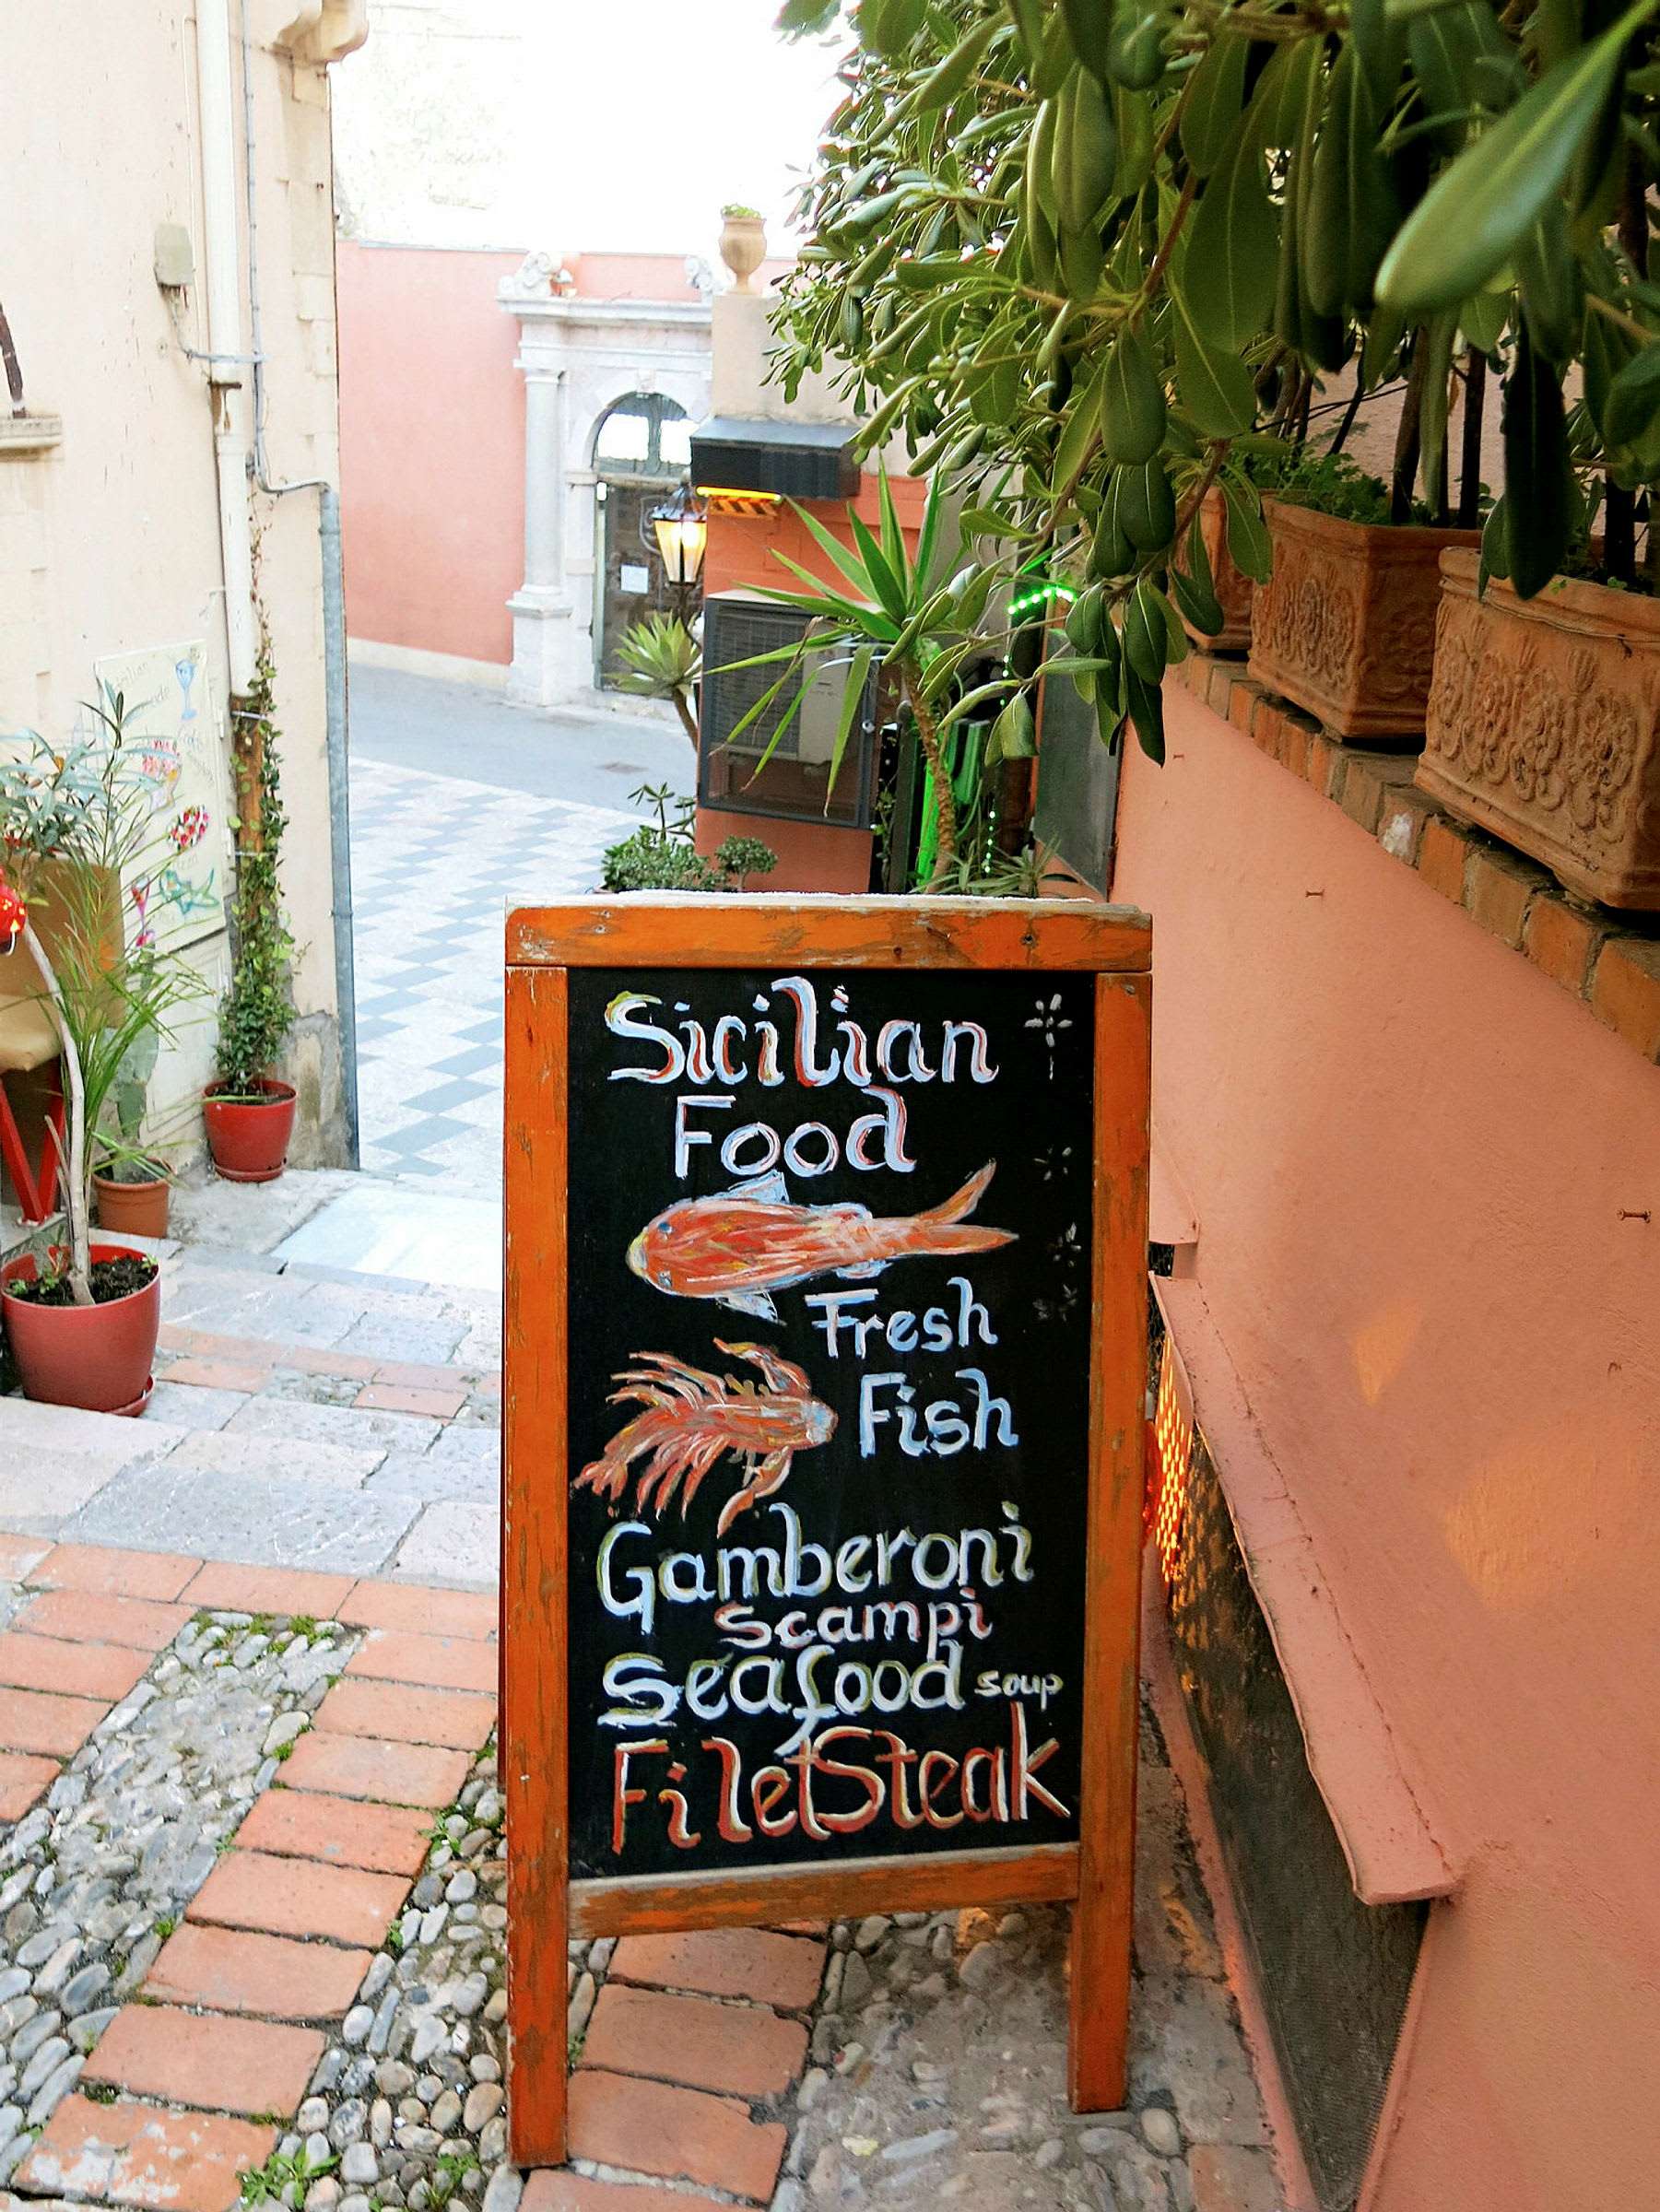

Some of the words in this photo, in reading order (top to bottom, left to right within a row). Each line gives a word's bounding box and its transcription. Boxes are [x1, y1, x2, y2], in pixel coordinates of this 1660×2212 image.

[605, 976, 999, 1088] Sicilian
[675, 1085, 916, 1178] Food
[805, 1276, 998, 1359] Fresh
[859, 1367, 1018, 1459] Fish
[598, 1501, 1033, 1634] Gamberoni
[597, 1640, 965, 1758] Seafood
[973, 1670, 1065, 1712] soup
